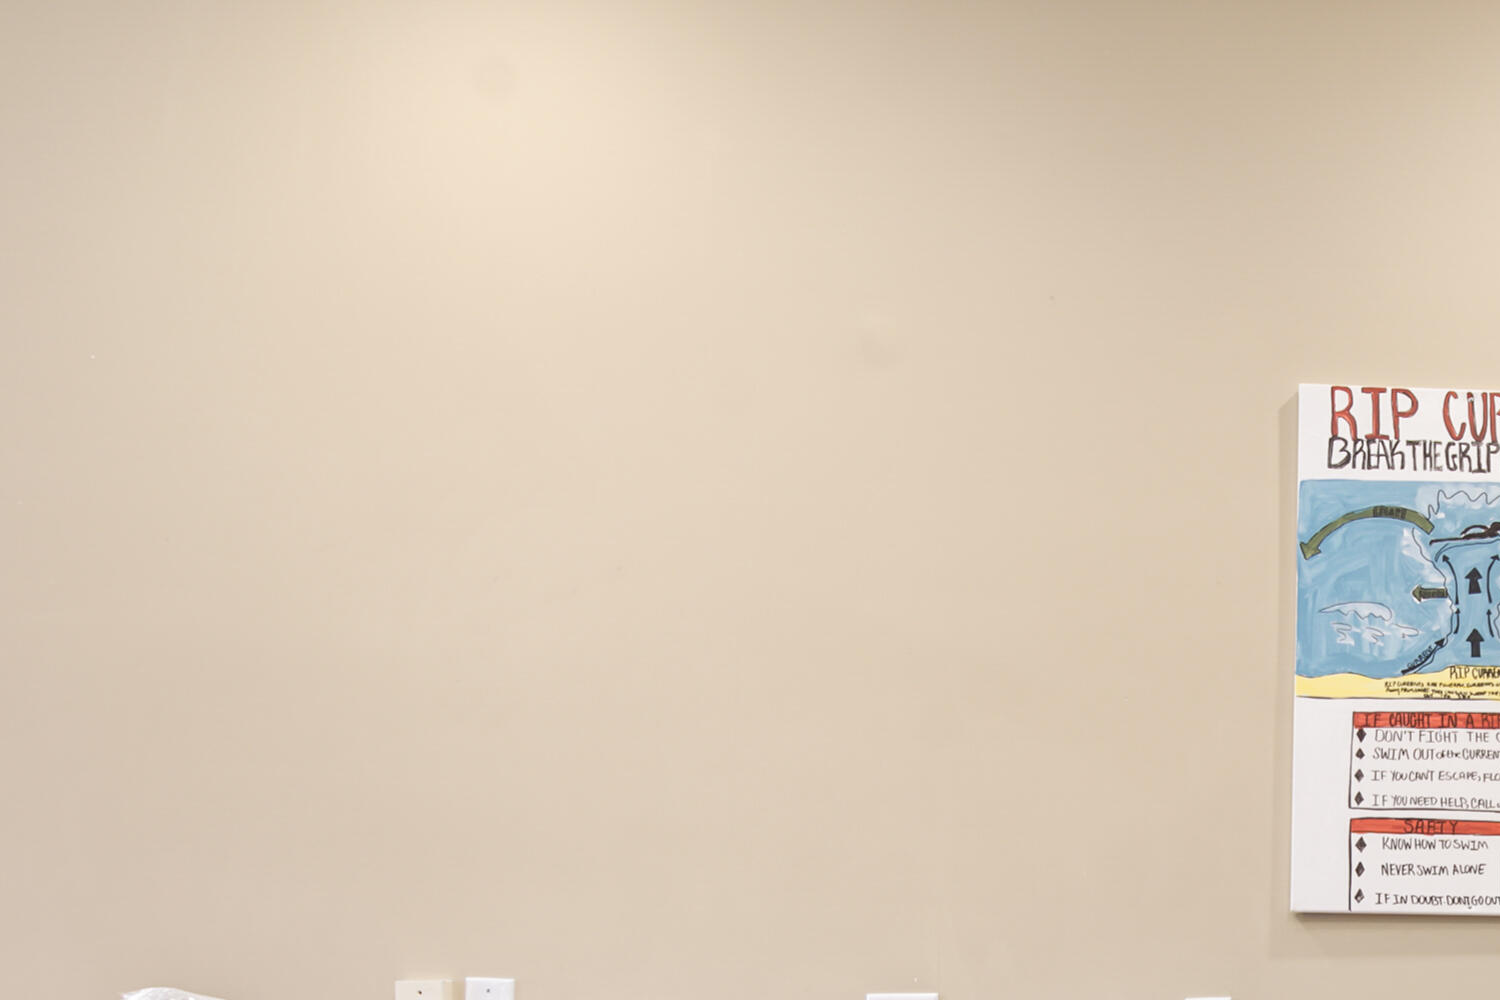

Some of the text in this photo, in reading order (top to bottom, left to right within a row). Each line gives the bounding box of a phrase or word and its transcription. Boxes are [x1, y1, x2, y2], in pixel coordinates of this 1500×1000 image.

[1331, 386, 1419, 440] RIP
[1327, 435, 1405, 470] BREAK
[1406, 439, 1443, 471] THE
[1445, 441, 1500, 474] GRIP
[1450, 666, 1469, 679] RIP
[1365, 712, 1383, 727] IF
[1389, 713, 1431, 727] CAUGHT
[1440, 713, 1457, 727] IN
[1466, 714, 1474, 728] A
[1374, 729, 1415, 742] DON'T
[1419, 731, 1458, 743] FIGHT
[1467, 732, 1489, 743] THE
[1373, 747, 1409, 760] SWIM
[1413, 748, 1434, 760] OUT
[1371, 770, 1387, 780] IF
[1390, 770, 1407, 781] YOU
[1372, 794, 1388, 806] IF
[1391, 795, 1407, 805] YOU
[1410, 796, 1437, 806] NEED
[1470, 797, 1496, 809] CALL
[1382, 836, 1488, 851] KNOW HOW TO SWIM
[1381, 863, 1487, 877] NEVER SWIM ALONE
[1375, 892, 1390, 905] IF
[1393, 894, 1407, 905] IN
[1471, 895, 1484, 906] GO
